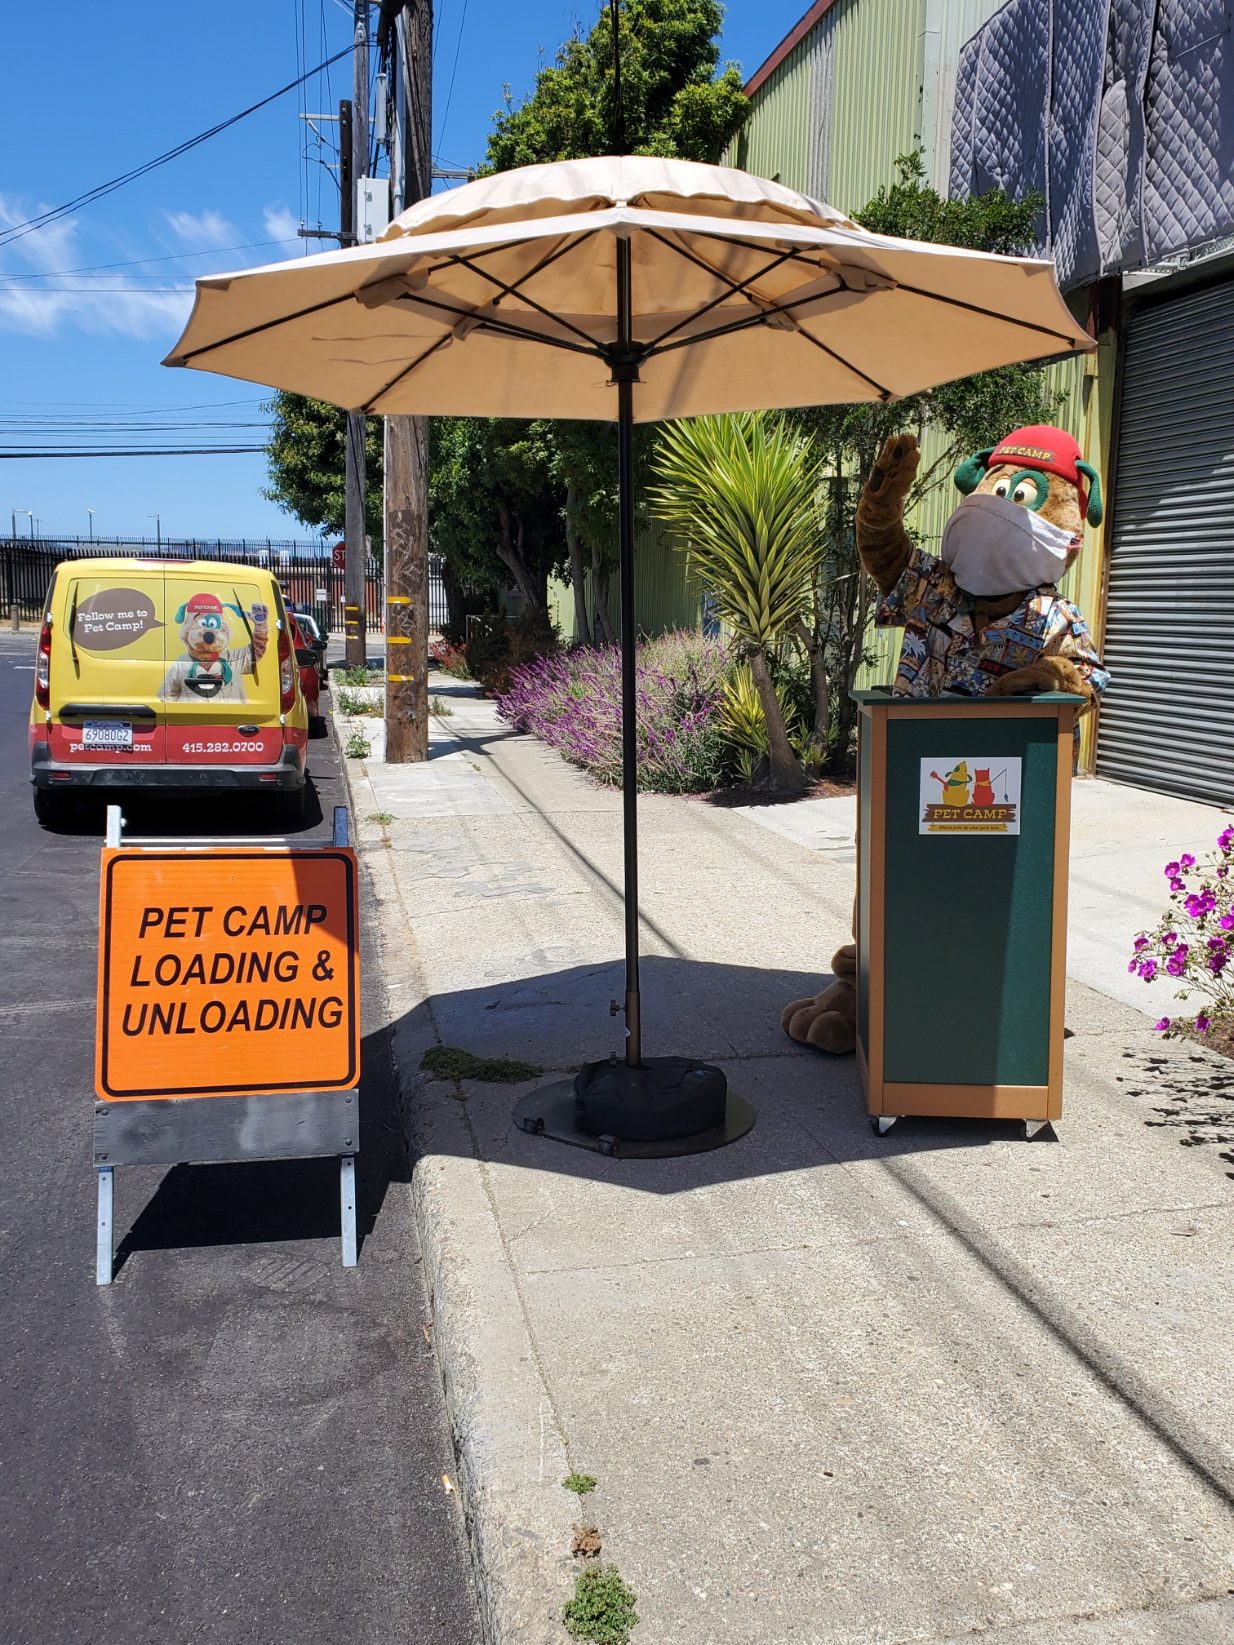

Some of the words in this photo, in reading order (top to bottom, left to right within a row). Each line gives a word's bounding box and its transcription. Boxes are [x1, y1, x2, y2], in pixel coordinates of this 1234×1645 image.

[999, 446, 1017, 454] PET
[1017, 447, 1050, 460] CAMP
[334, 549, 346, 561] ST
[77, 611, 115, 622] Follow
[117, 611, 135, 619] me
[136, 609, 148, 618] to
[84, 623, 104, 633] Pet
[105, 620, 144, 632] Camp!
[85, 729, 129, 742] 69080G2
[69, 743, 152, 754] petcamp.com
[182, 741, 264, 753] 415.282.0700
[933, 809, 960, 819] PET
[963, 809, 1007, 819] CAMP
[139, 907, 213, 939] PET
[223, 905, 328, 938] CAMP
[130, 951, 300, 987] LOADING
[312, 950, 335, 982] &
[122, 997, 344, 1037] UNLOADING
